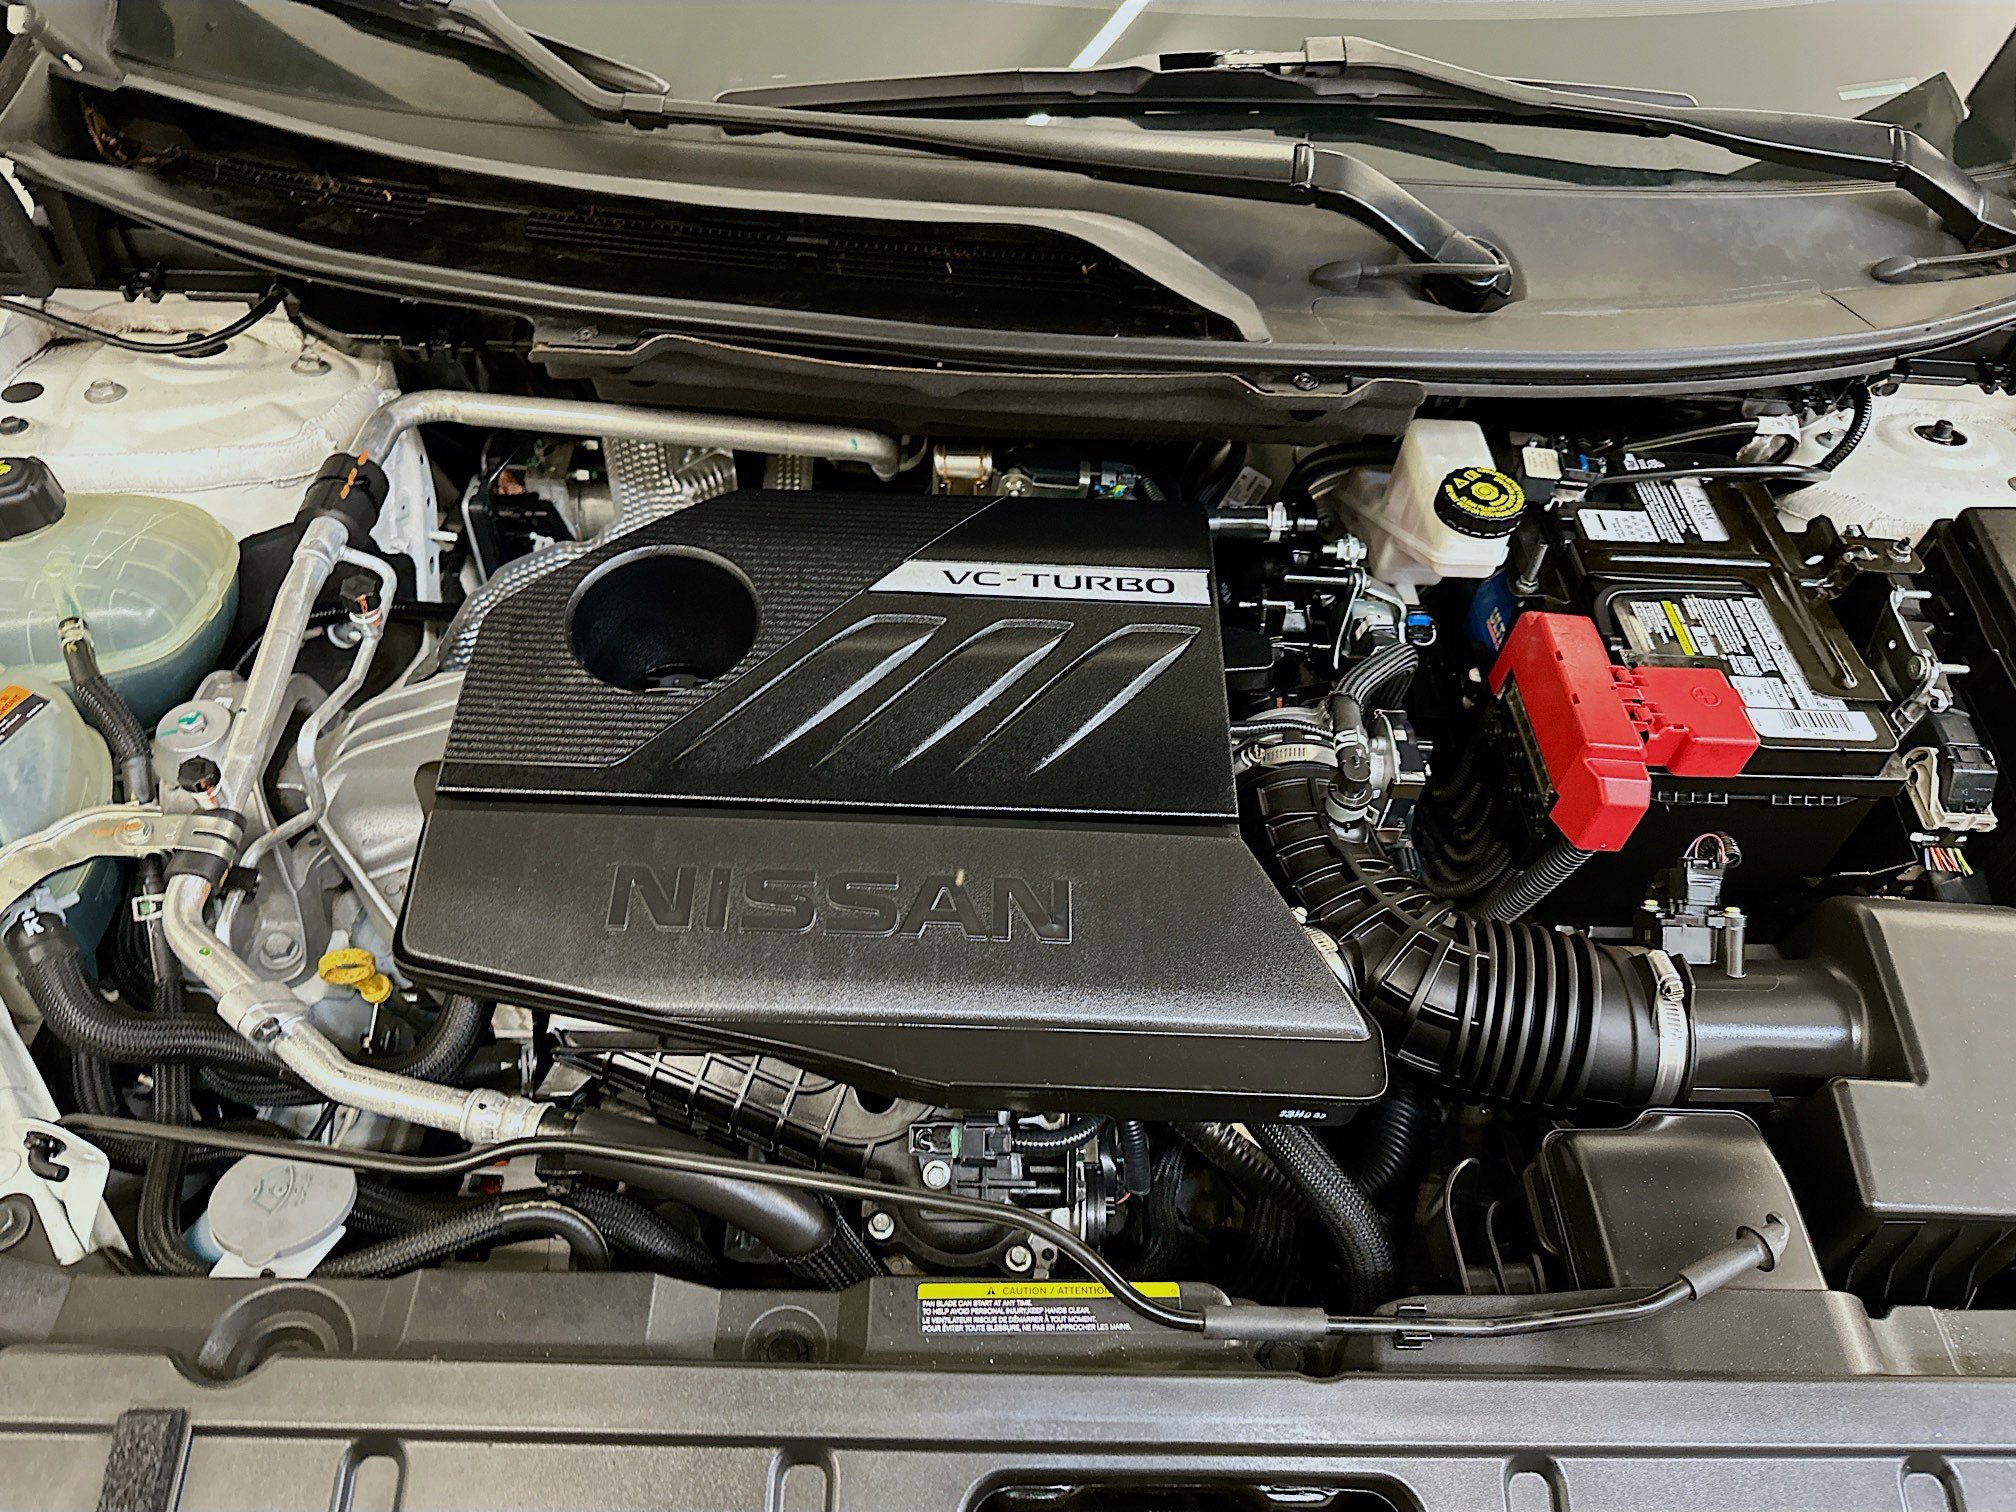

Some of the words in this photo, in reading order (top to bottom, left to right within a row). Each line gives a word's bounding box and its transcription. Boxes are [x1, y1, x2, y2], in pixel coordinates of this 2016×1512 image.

[1683, 487, 1710, 531] TECHNOLOGY
[1695, 498, 1715, 521] AGM
[942, 570, 1175, 594] VC-TURBO
[1697, 635, 1708, 647] Pb
[605, 864, 1073, 944] NISSAN
[1002, 1286, 1047, 1295] CAUTION
[922, 1300, 935, 1308] FAN
[936, 1300, 957, 1308] BLADE
[922, 1308, 931, 1316] TO
[932, 1308, 949, 1316] HELP
[950, 1308, 970, 1316] AVOID
[922, 1316, 930, 1325] LE
[931, 1316, 973, 1324] VENTILATEUR
[973, 1316, 998, 1324] RISQUE
[999, 1316, 1008, 1324] DE
[1008, 1314, 1044, 1324] DÉMARRER
[922, 1325, 941, 1333] POUR
[941, 1323, 964, 1333] ÉVITER
[964, 1324, 985, 1333] TOUTE
[1022, 1324, 1031, 1332] NE
[1032, 1324, 1046, 1332] PAS
[1056, 1324, 1096, 1332] APPROCHER
[1096, 1323, 1109, 1331] LES
[1109, 1323, 1132, 1331] MAINS.
